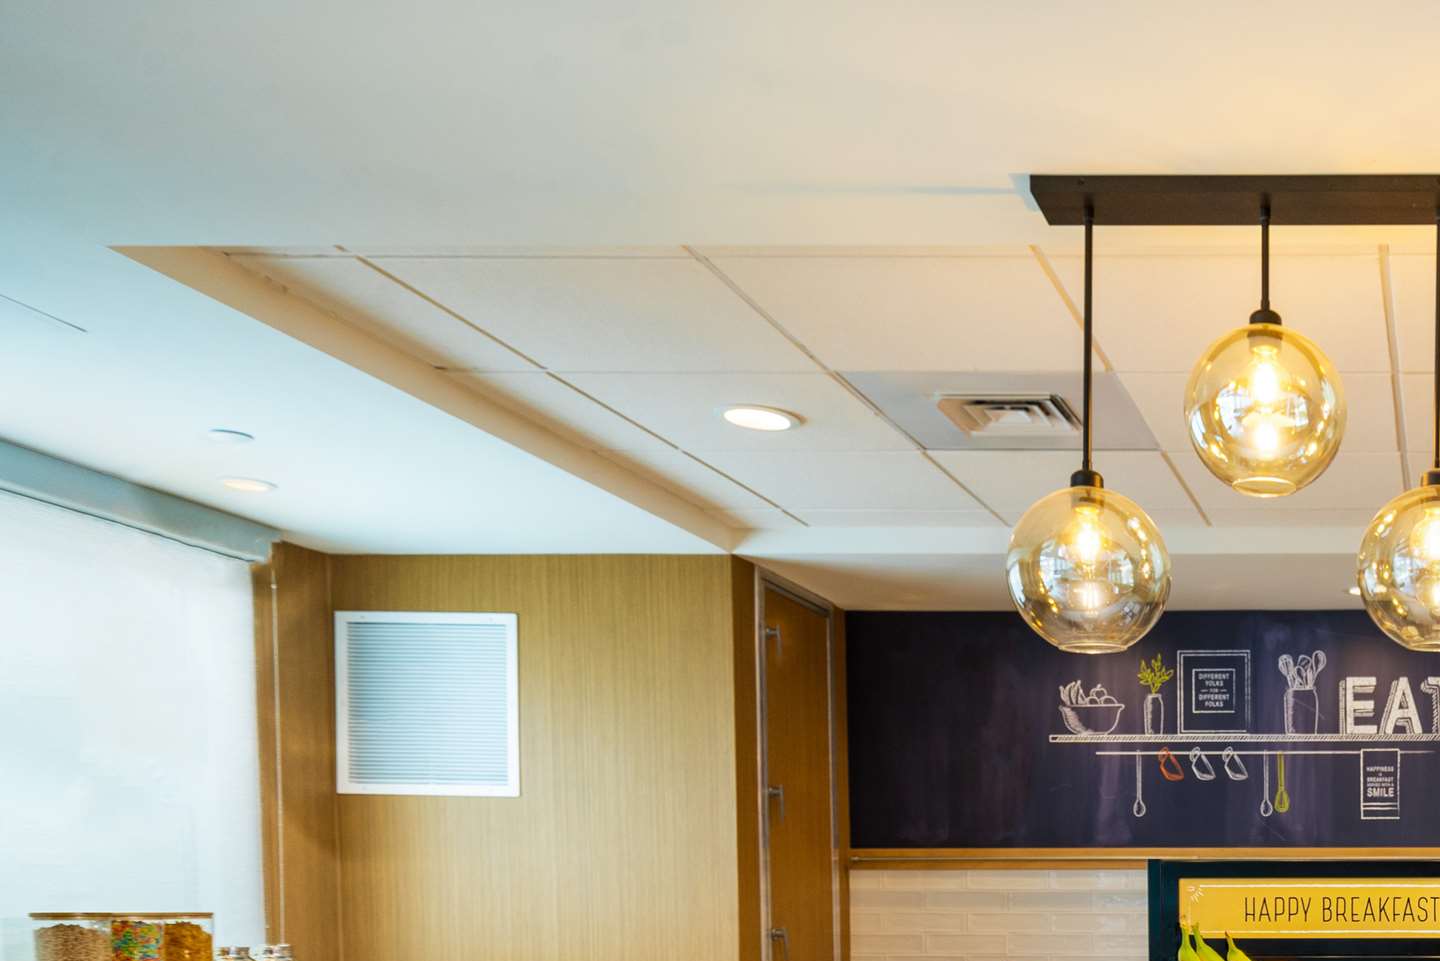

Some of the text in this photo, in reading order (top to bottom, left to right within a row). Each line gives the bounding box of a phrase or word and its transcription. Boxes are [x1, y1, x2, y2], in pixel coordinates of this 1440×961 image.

[1366, 787, 1395, 797] SMILE
[1243, 896, 1312, 923] HAPPY
[1321, 896, 1440, 923] BREAKFAST
